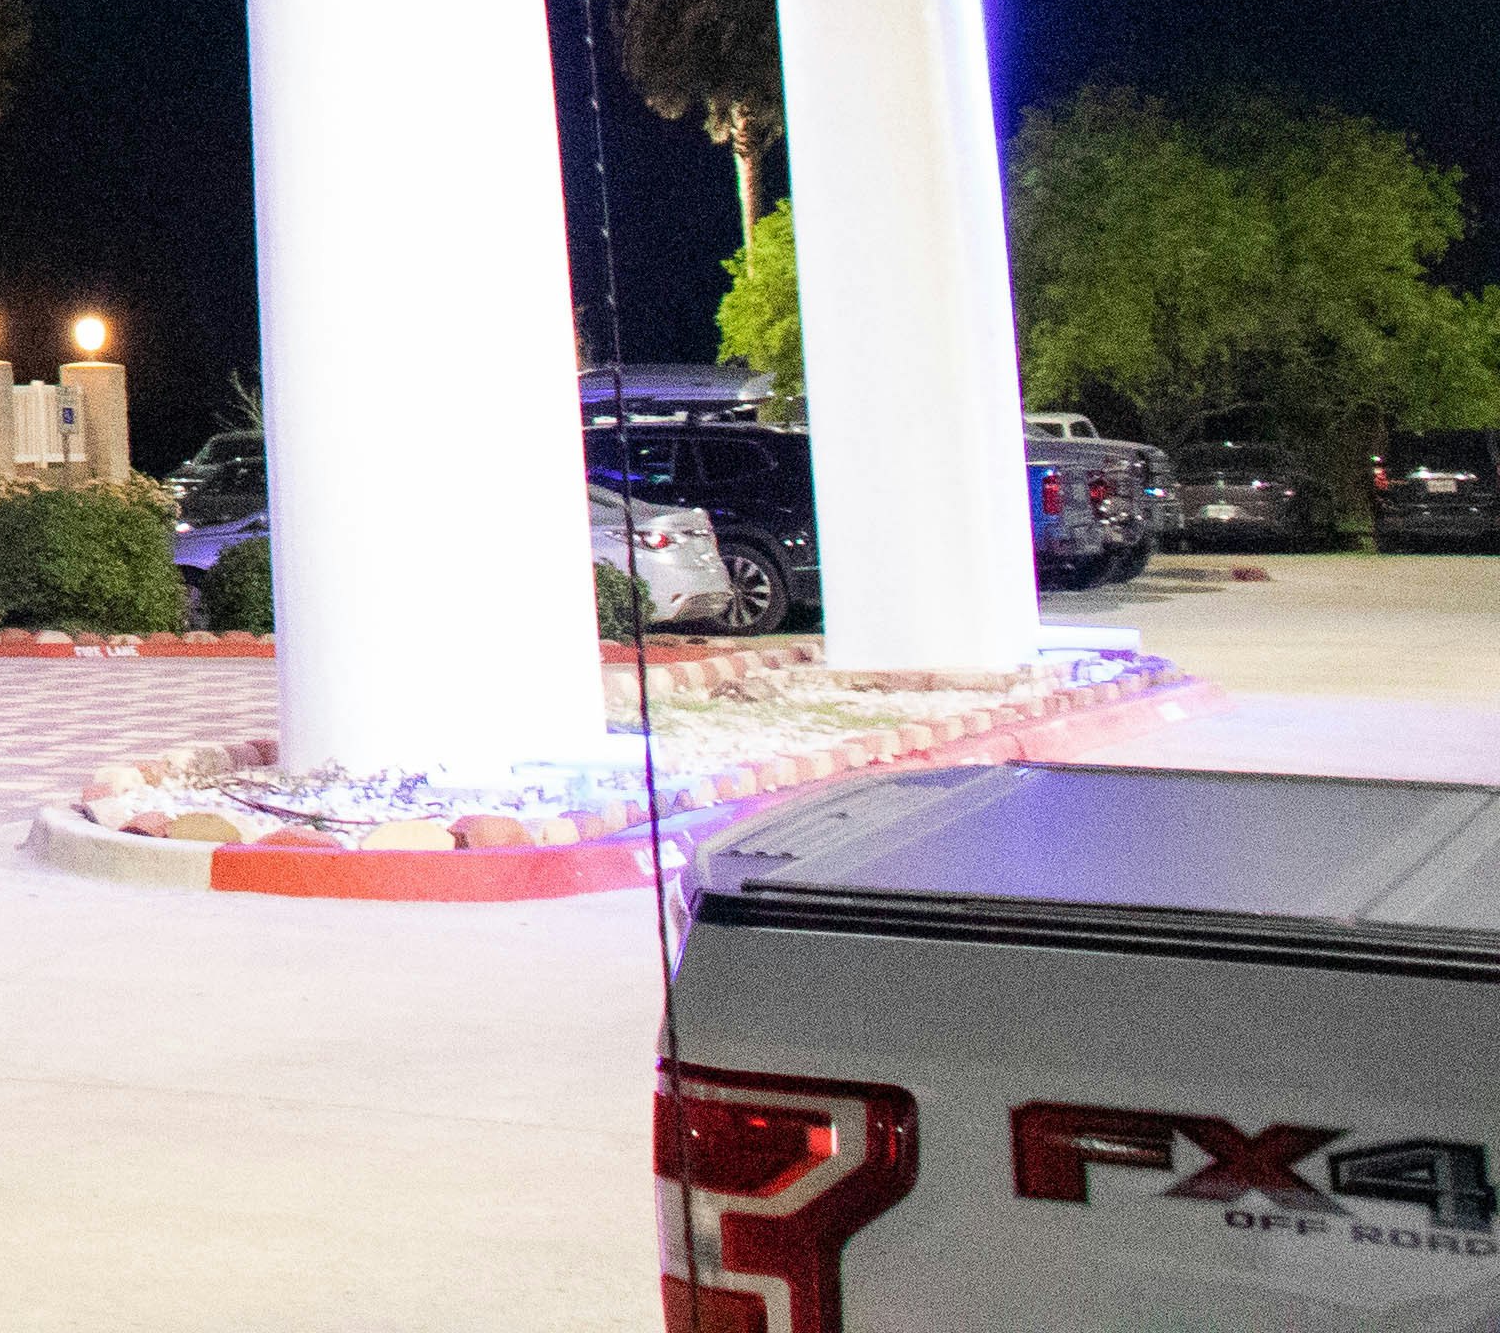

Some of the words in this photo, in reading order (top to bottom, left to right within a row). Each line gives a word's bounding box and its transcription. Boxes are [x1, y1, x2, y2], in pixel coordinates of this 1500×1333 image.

[1009, 1099, 1498, 1233] FX4
[1223, 1209, 1327, 1235] OFF
[1350, 1225, 1500, 1257] ROAD
